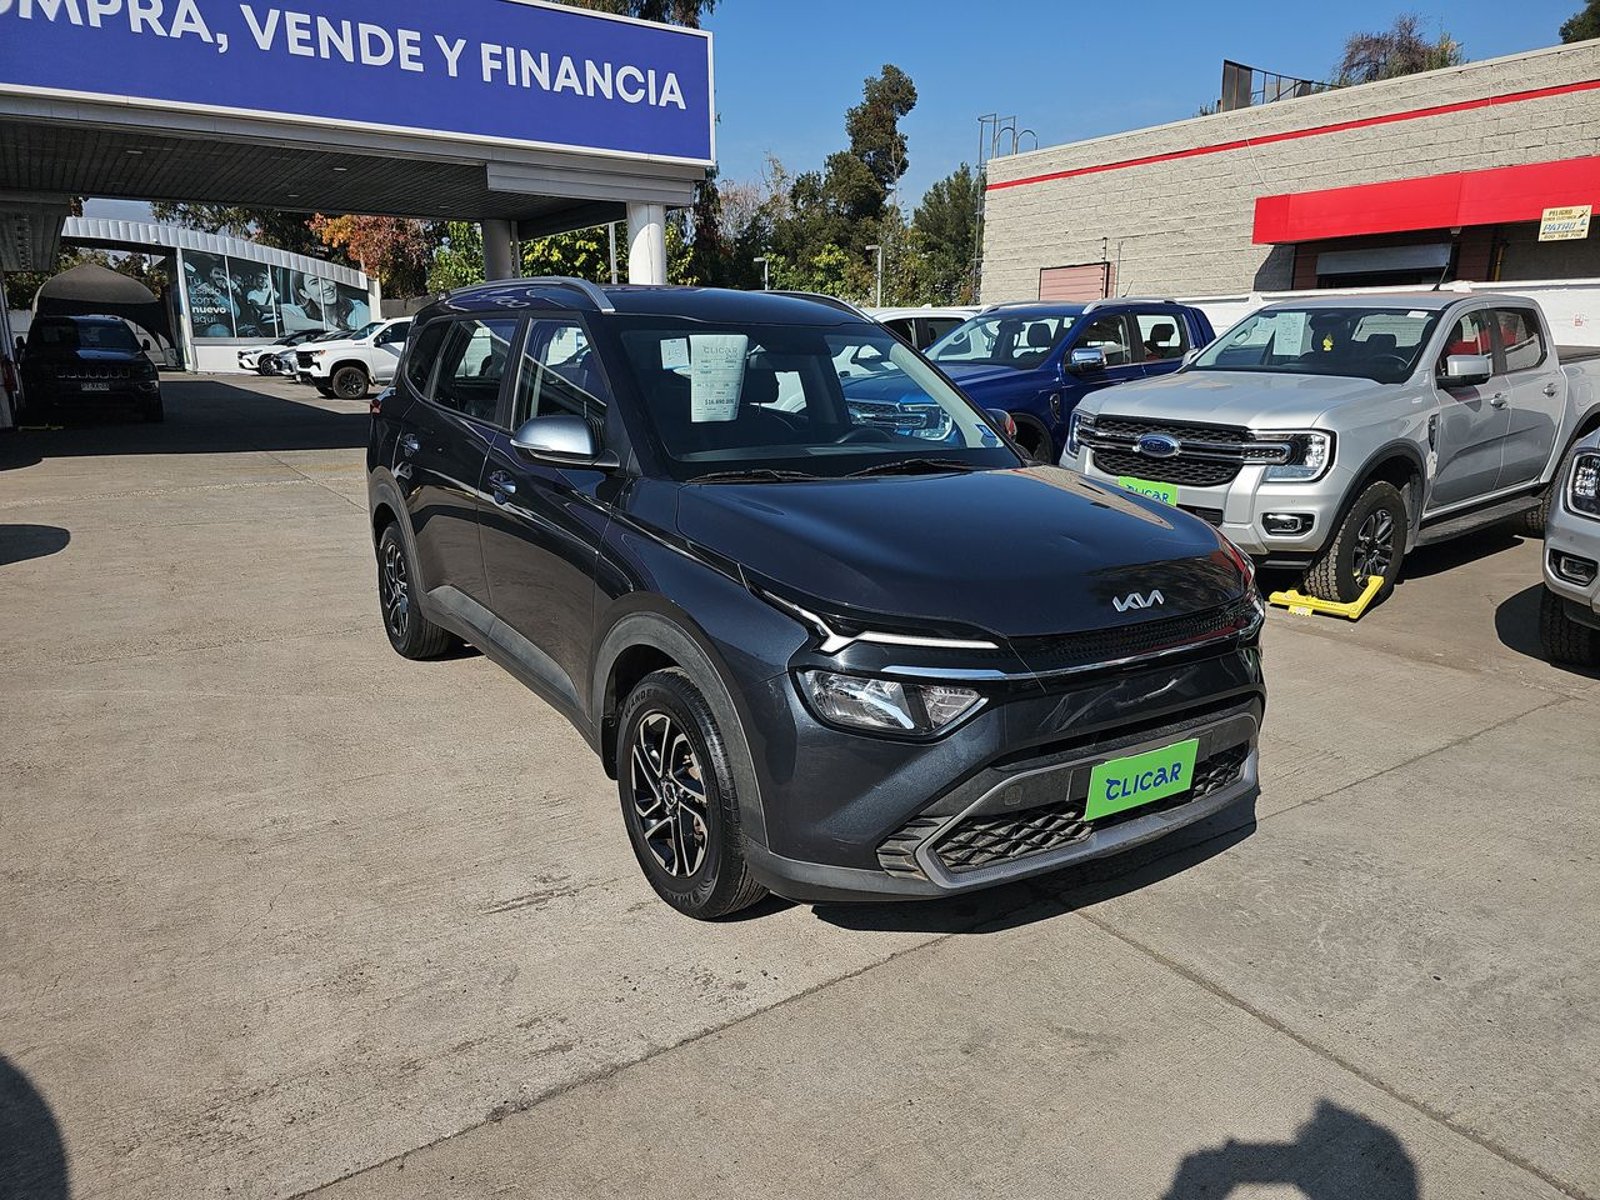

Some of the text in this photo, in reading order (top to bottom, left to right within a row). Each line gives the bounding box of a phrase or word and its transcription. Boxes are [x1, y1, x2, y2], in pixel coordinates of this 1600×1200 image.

[0, 0, 687, 110] PRA, VENDE Y FINANCIA
[191, 296, 221, 305] como
[192, 306, 227, 314] nuevo
[1112, 589, 1165, 612] KIA
